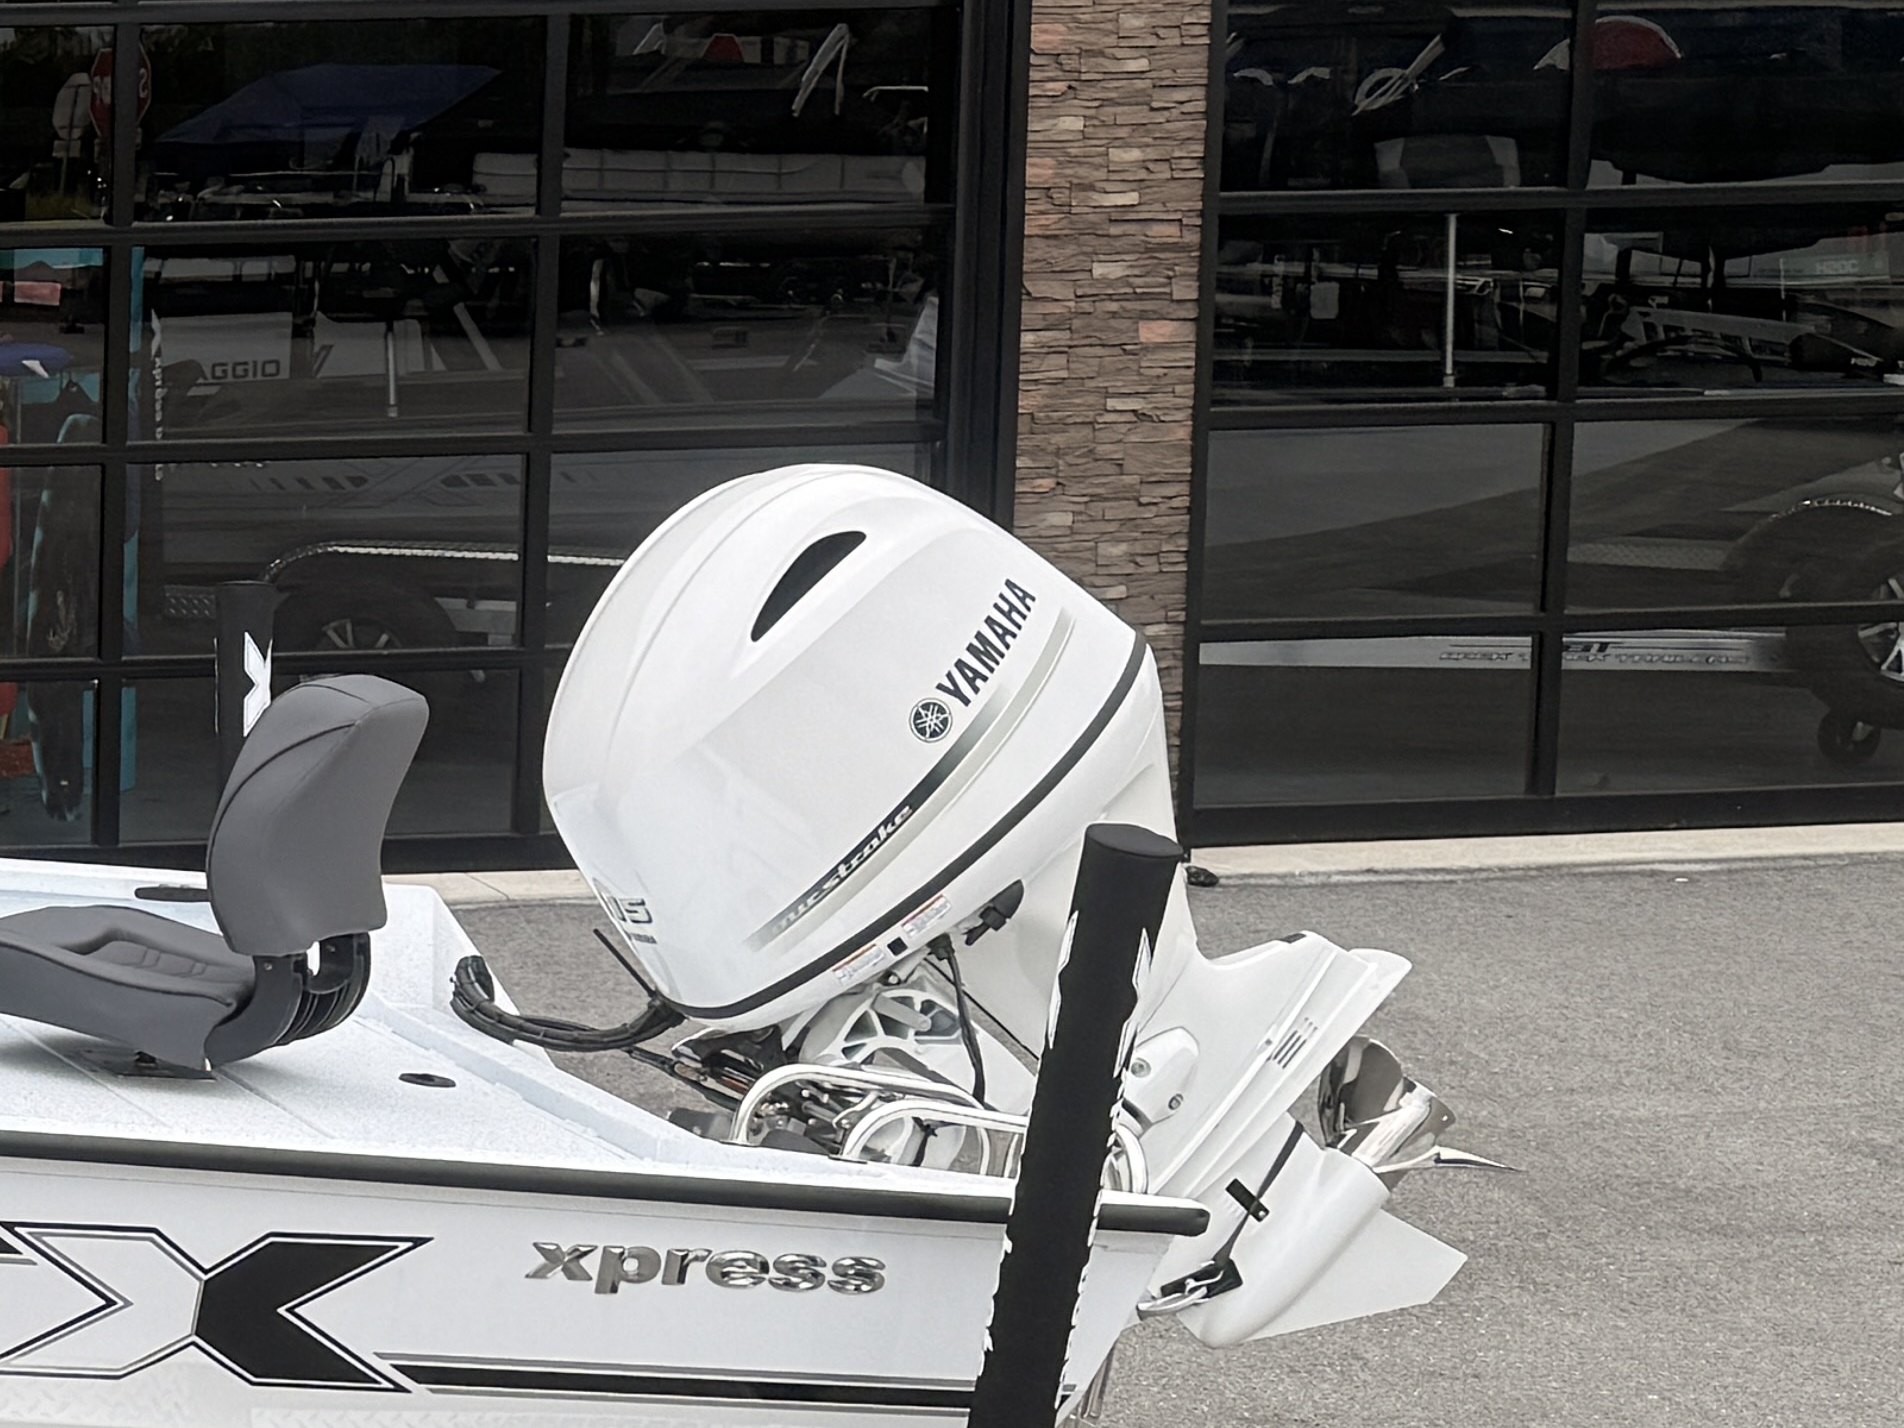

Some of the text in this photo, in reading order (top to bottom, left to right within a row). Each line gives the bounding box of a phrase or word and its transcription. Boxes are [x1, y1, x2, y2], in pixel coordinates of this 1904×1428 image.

[935, 577, 1037, 706] YAMAHA
[770, 804, 913, 934] ourstroke
[525, 1237, 887, 1295] xpress
